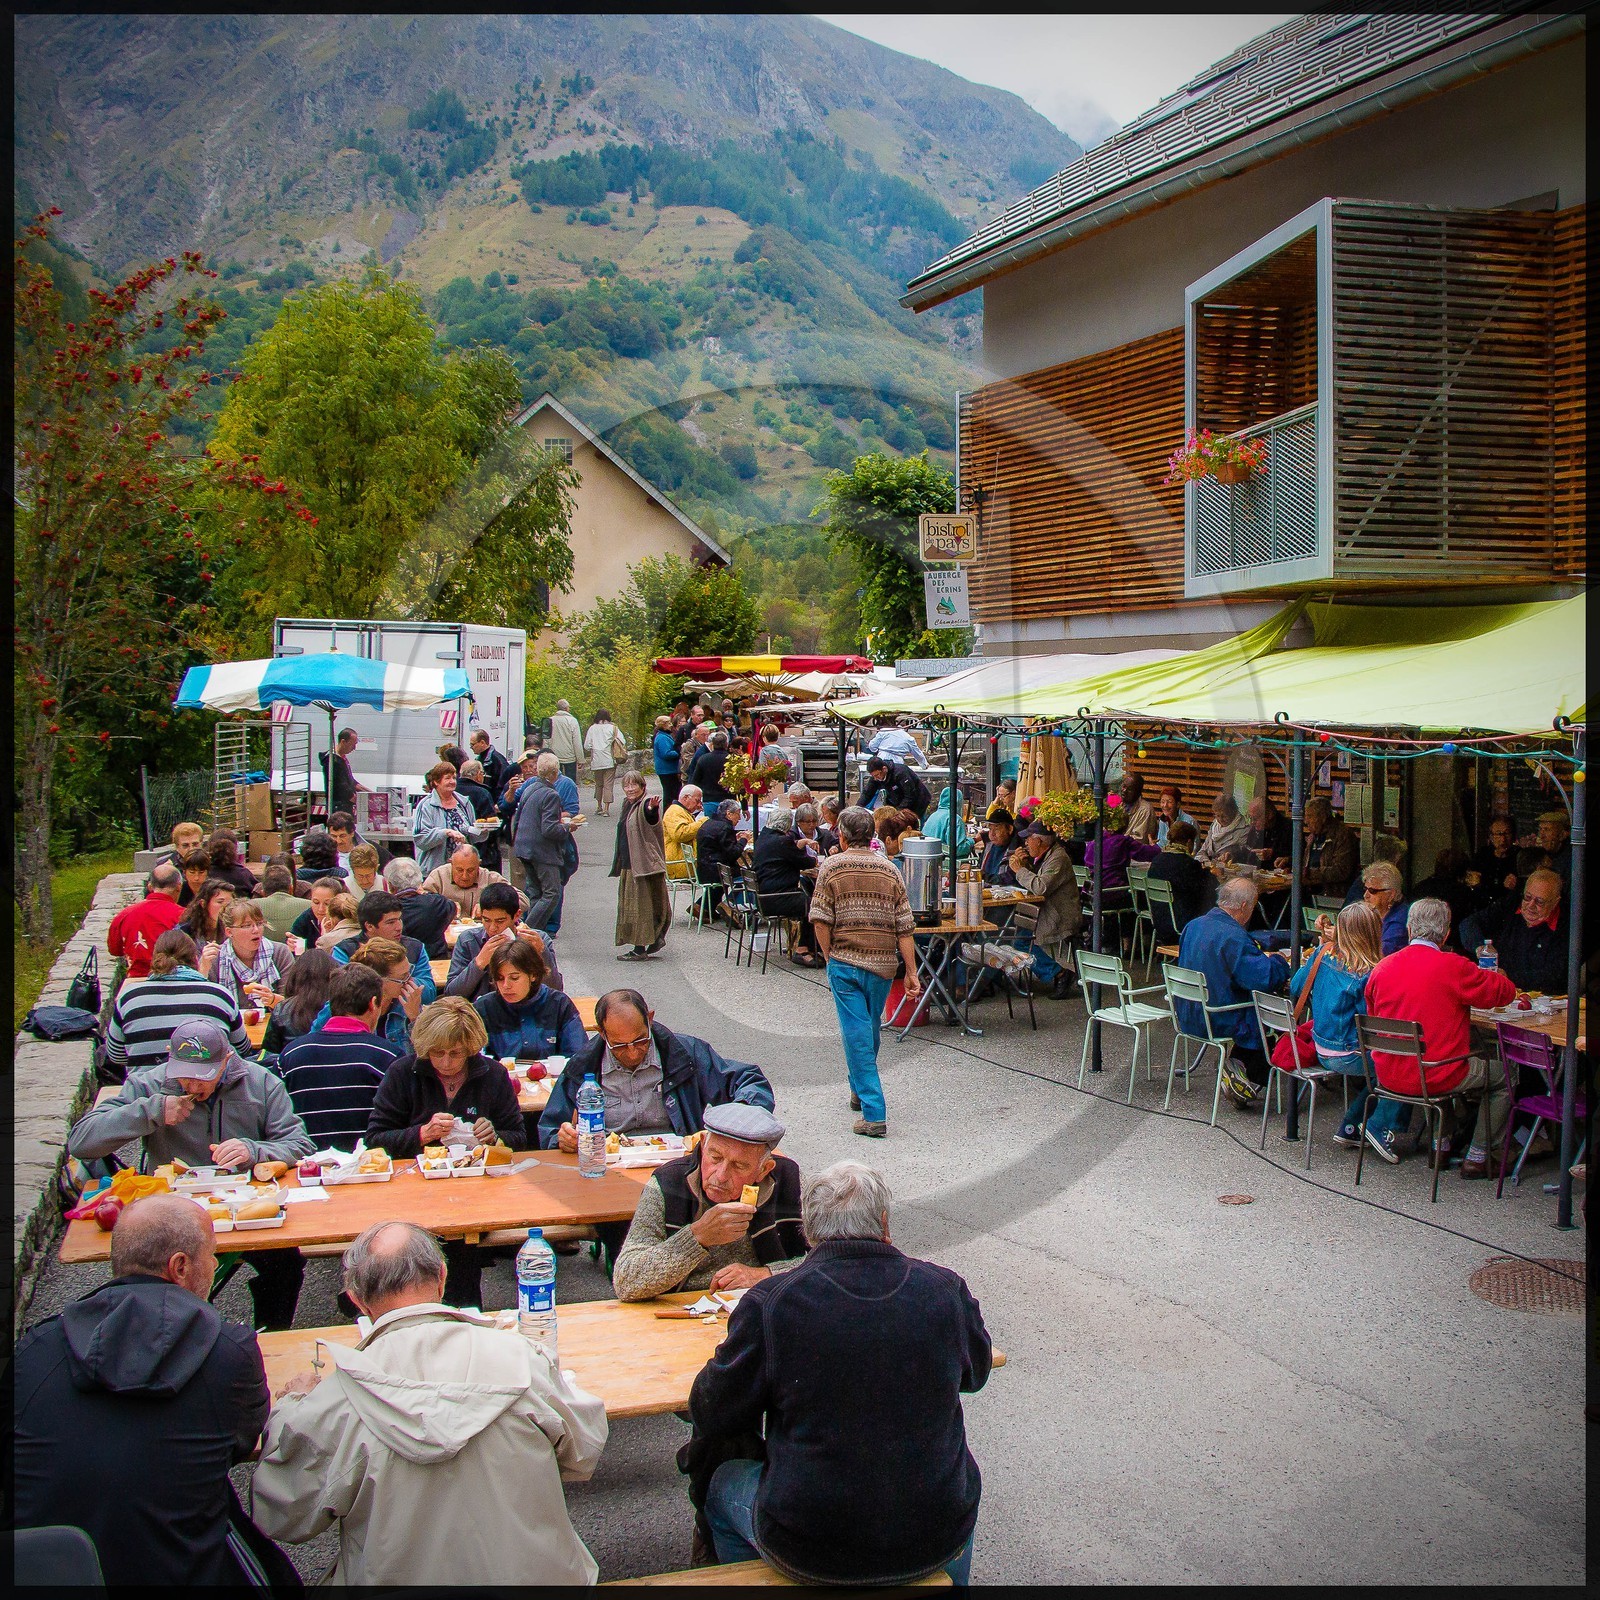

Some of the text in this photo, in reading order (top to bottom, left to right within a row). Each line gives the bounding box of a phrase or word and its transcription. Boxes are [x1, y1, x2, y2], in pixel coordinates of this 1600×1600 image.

[926, 520, 971, 537] bistrot
[935, 538, 970, 554] pays
[928, 572, 961, 580] AUBERGE
[937, 586, 962, 594] ECRINS
[476, 668, 500, 682] TRAITEUR
